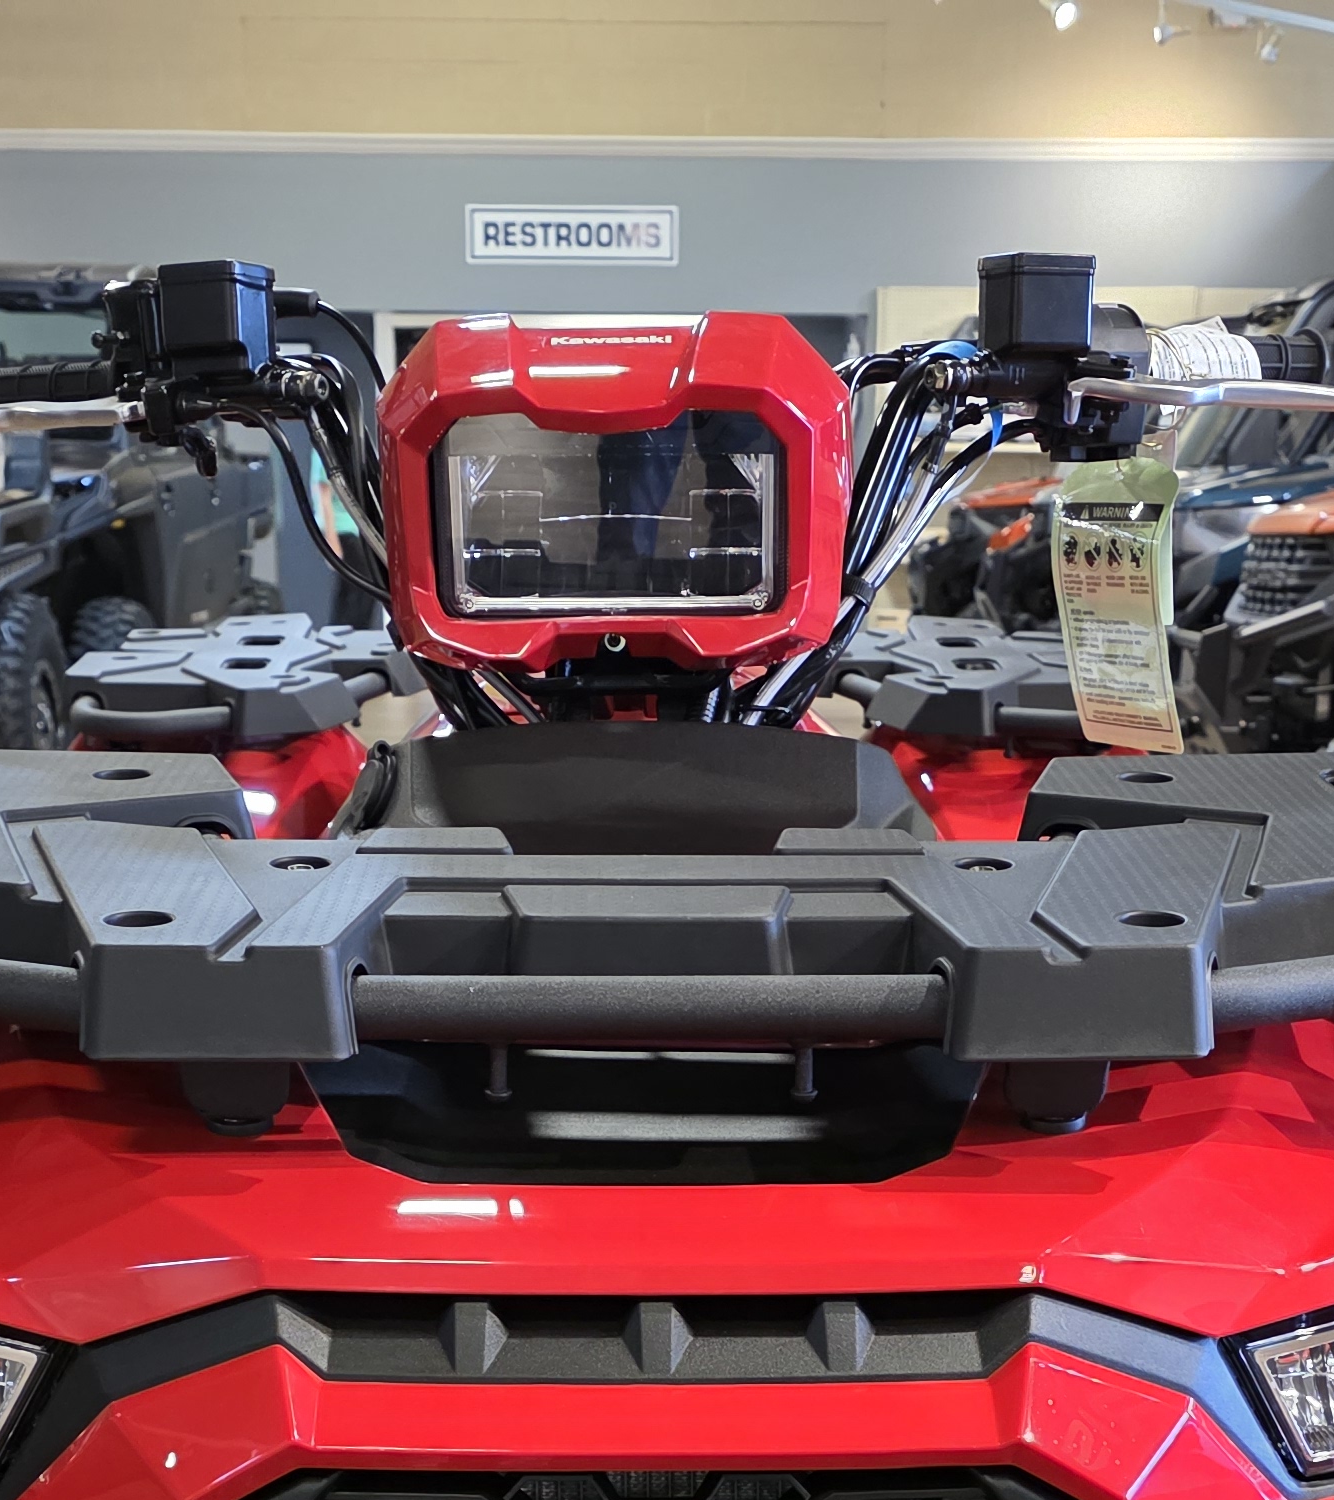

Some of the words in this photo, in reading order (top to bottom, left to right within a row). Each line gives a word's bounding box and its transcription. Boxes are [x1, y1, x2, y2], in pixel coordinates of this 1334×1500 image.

[483, 221, 661, 248] RESTROOMS
[550, 334, 673, 346] Kawasaki
[1092, 506, 1144, 519] WARNIN
